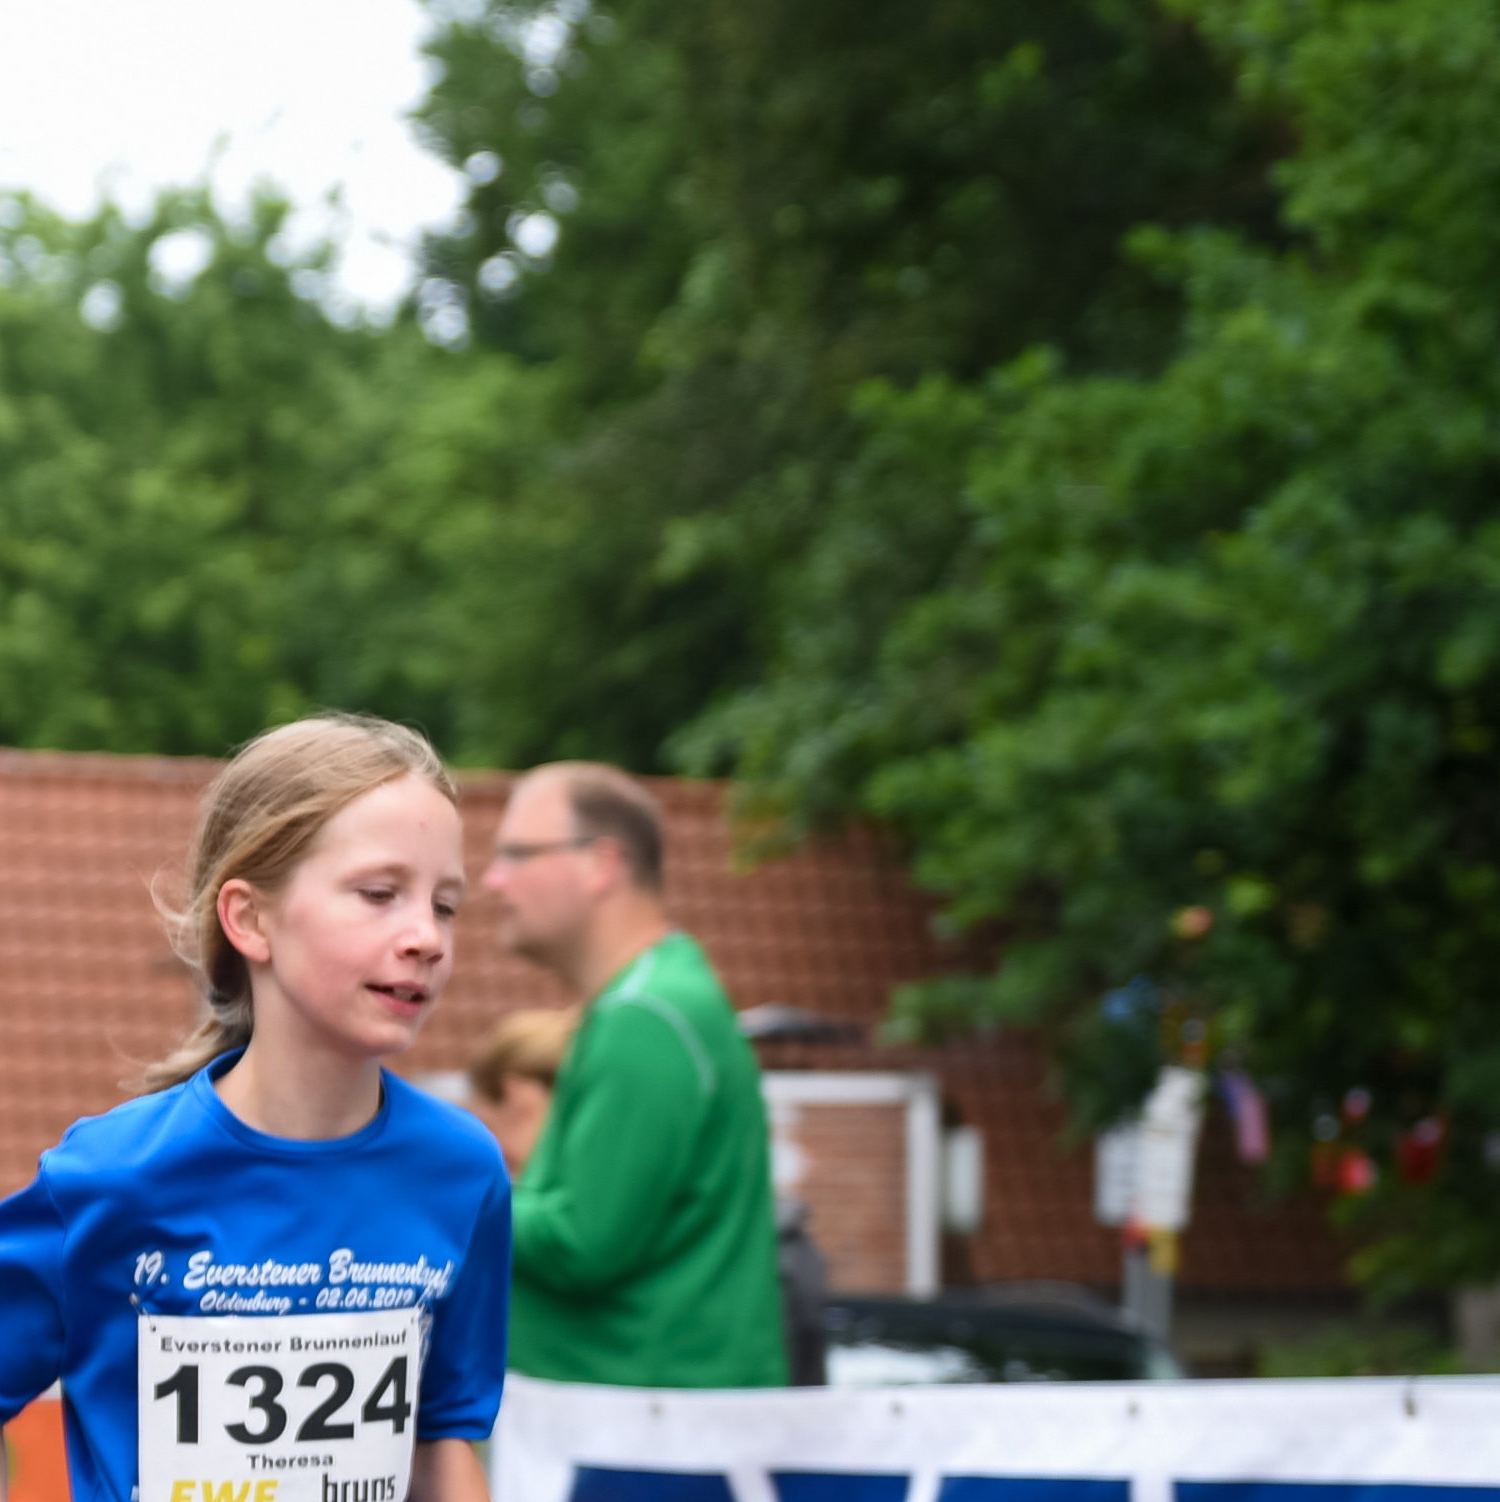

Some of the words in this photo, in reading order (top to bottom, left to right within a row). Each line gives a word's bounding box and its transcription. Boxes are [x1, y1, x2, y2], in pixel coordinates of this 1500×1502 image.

[133, 1250, 170, 1285] 19.
[183, 1250, 322, 1290] Everstener
[200, 1289, 292, 1316] Oldenburg
[315, 1286, 415, 1309] 02.06.2019
[160, 1336, 282, 1353] Everstener
[289, 1329, 407, 1352] Brunnenlauf
[154, 1355, 411, 1445] 1324
[246, 1453, 334, 1470] Theresa
